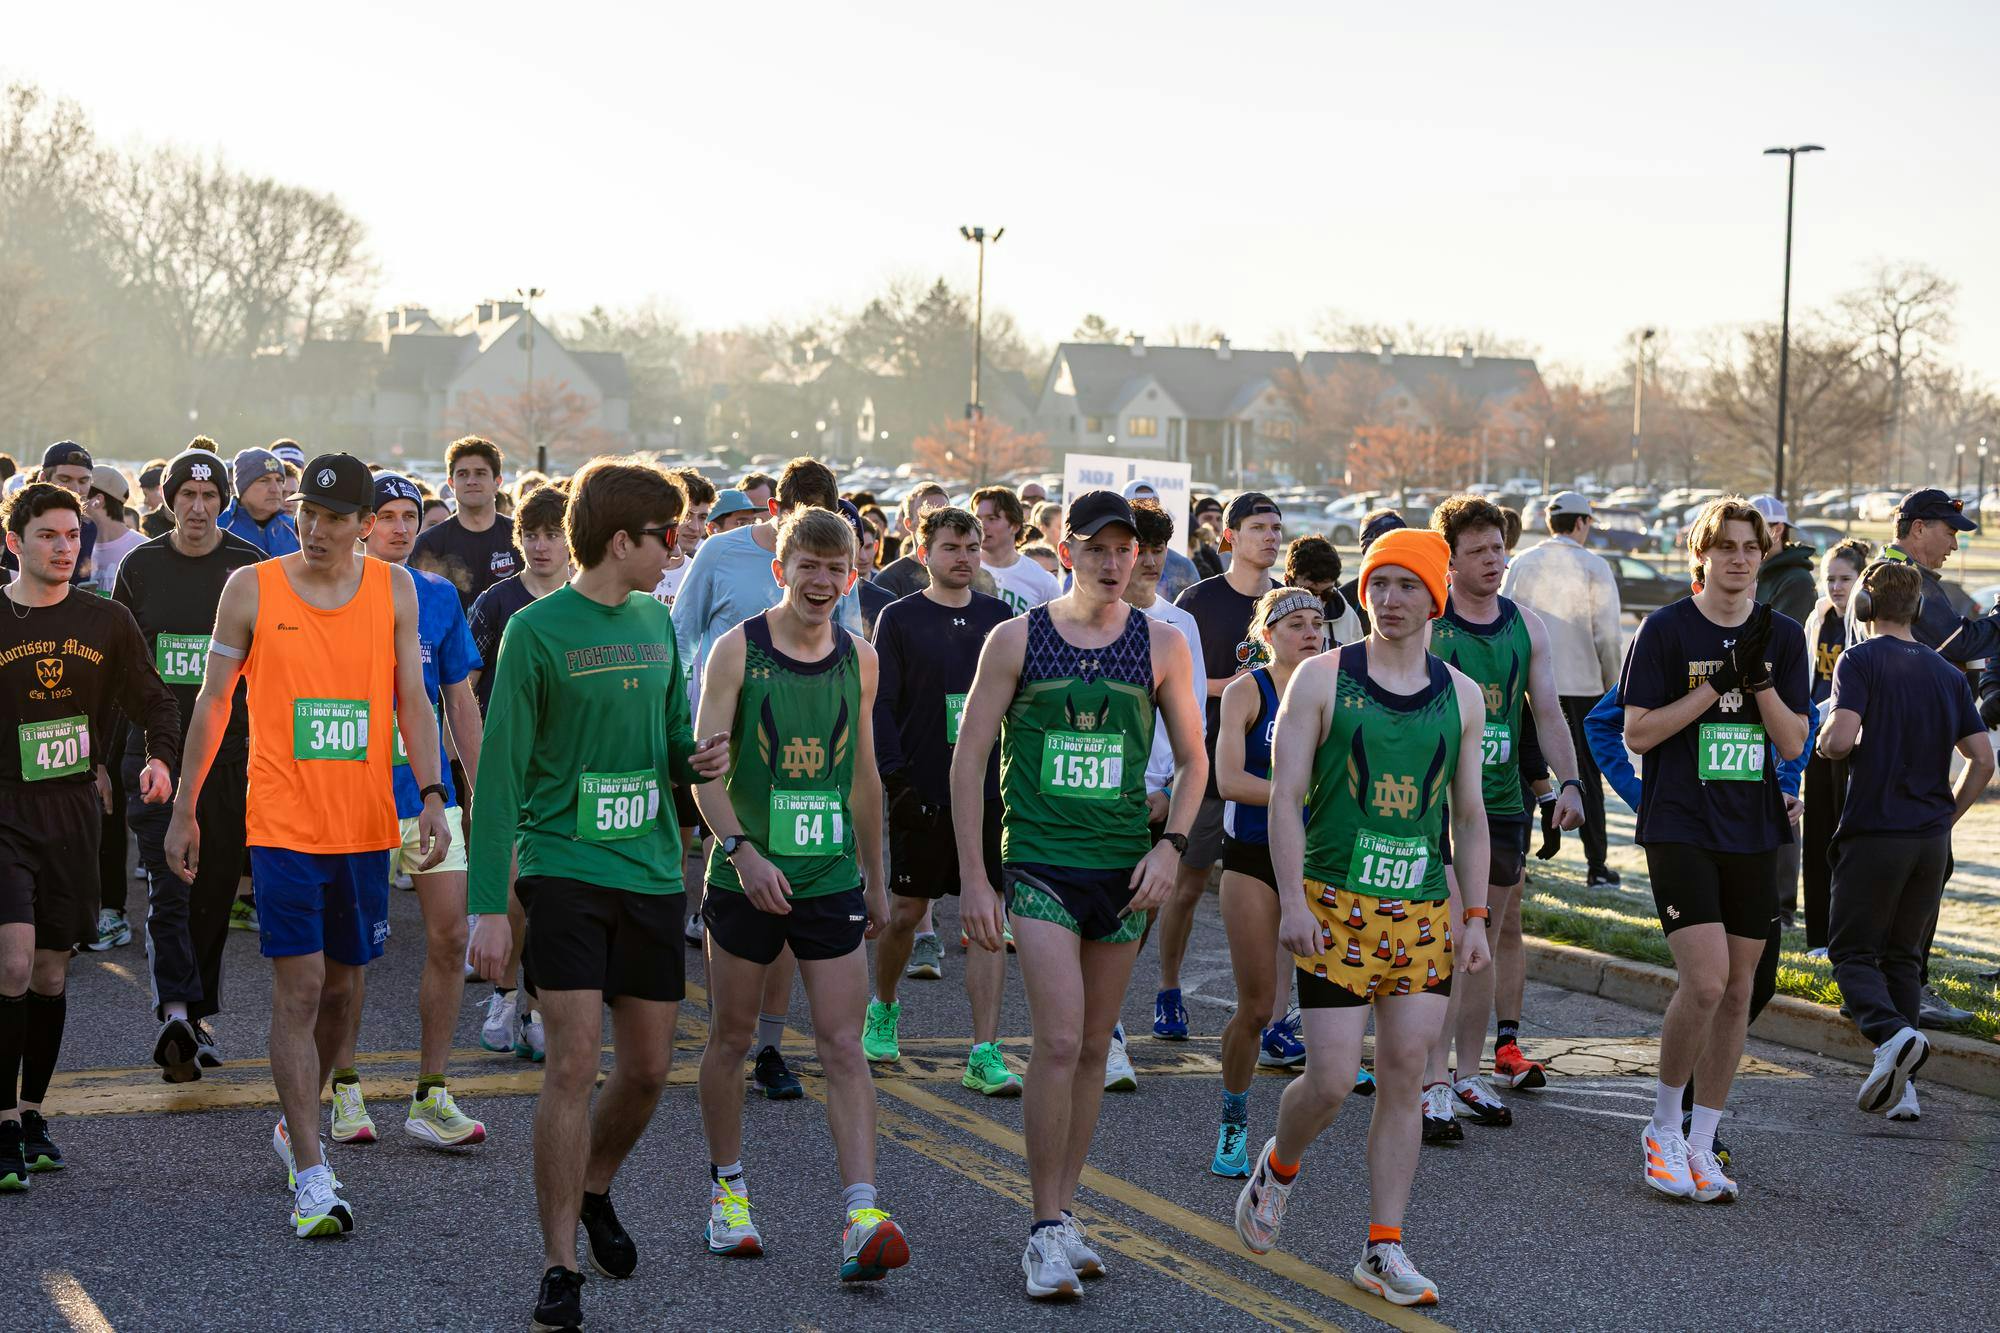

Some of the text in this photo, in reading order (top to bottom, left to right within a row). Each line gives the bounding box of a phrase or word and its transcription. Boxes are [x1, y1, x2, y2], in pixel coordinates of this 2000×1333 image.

[61, 638, 104, 665] Manor
[160, 640, 172, 648] 13.1
[566, 644, 636, 671] FIGHTING
[297, 707, 312, 716] 13.1
[313, 708, 331, 717] HOLY
[332, 708, 350, 717] HALF
[355, 710, 367, 718] 10K
[22, 731, 37, 741] 13.1
[37, 729, 54, 739] HOLY
[54, 727, 70, 737] HALF
[310, 720, 355, 750] 340
[1702, 731, 1715, 740] 13.1
[1716, 732, 1732, 740] HOLY
[36, 738, 78, 770] 420
[1048, 739, 1064, 749] 13.1
[1084, 744, 1102, 753] HALF
[1108, 745, 1122, 754] 10K
[1052, 754, 1112, 788] 1531
[583, 783, 600, 793] 13.1
[600, 784, 621, 794] HOLY
[622, 782, 640, 792] HALF
[645, 779, 656, 789] 10K
[597, 795, 644, 830] 580
[774, 800, 790, 810] 13.1
[790, 801, 808, 810] HOLY
[809, 801, 825, 810] HALF
[829, 802, 840, 810] 10K
[794, 814, 824, 845] 64
[1358, 837, 1375, 850] 13.1
[1375, 843, 1393, 854] HOLY
[1394, 846, 1414, 856] HALF
[1358, 854, 1418, 889] 1591
